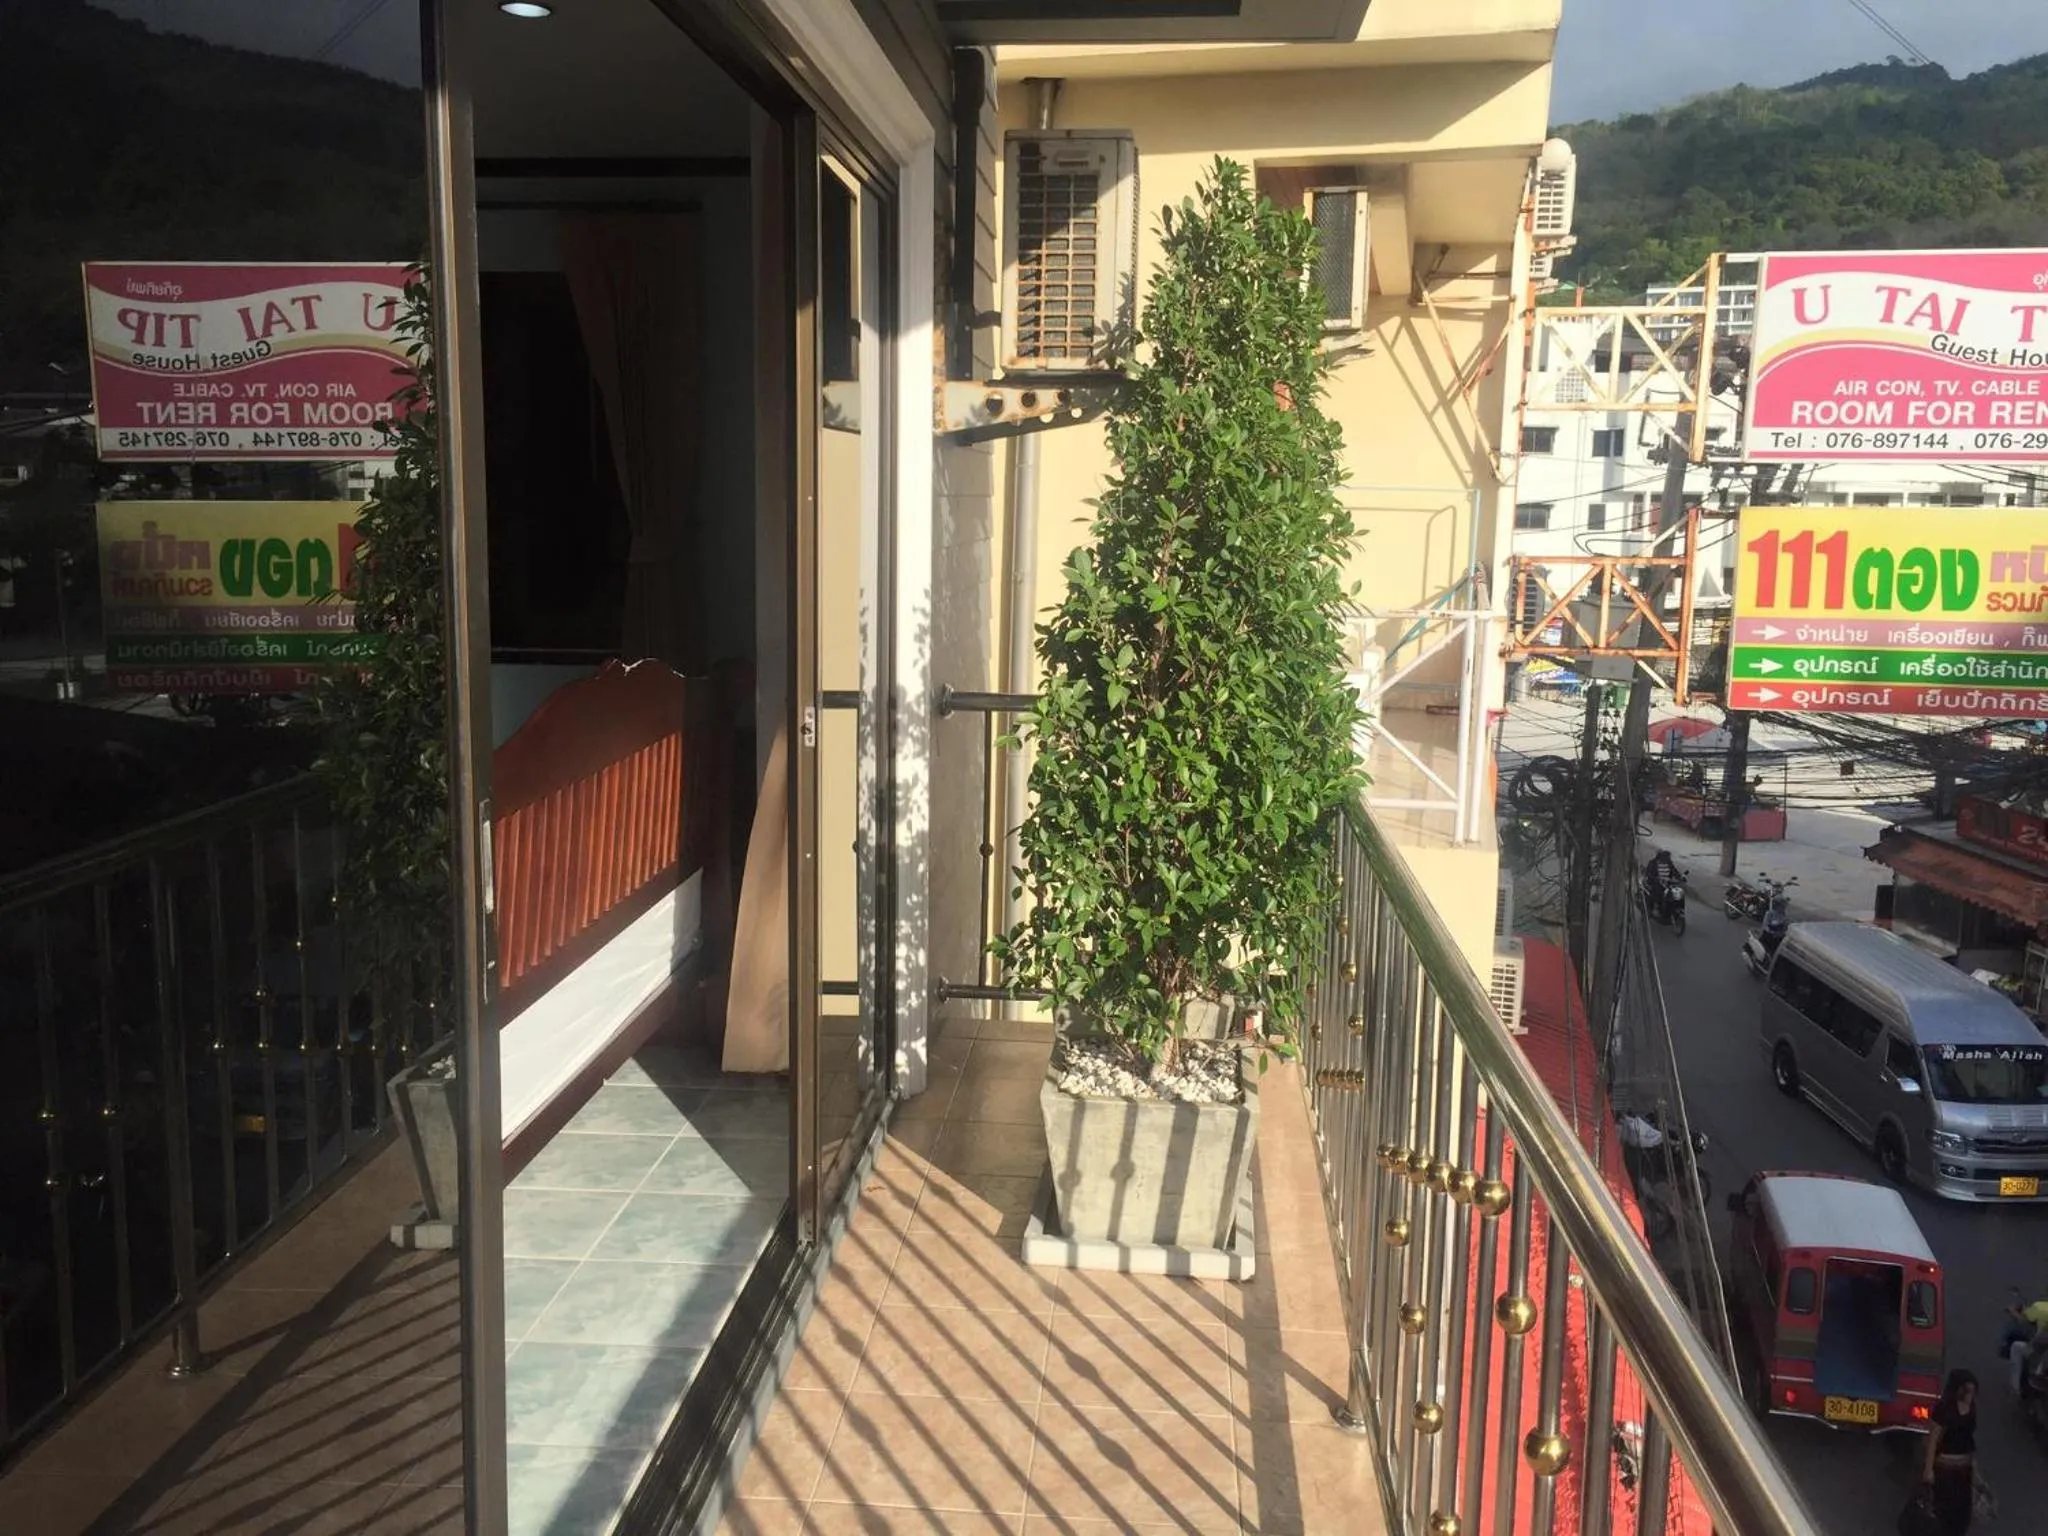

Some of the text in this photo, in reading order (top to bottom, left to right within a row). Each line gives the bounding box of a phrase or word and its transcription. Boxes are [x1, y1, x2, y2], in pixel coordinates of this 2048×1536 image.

[1792, 284, 1832, 325] U
[1875, 285, 1972, 336] TAI
[1930, 333, 1999, 365] Guest
[1834, 380, 1868, 397] AIR
[1971, 380, 2040, 397] CABLE
[1791, 401, 1893, 426] ROOM
[1907, 401, 1975, 426] FOR
[1771, 432, 1802, 449] Tel
[1826, 432, 1949, 450] 076-897144
[1796, 622, 1868, 643] จำหน่าย
[1887, 621, 1994, 645] เครื่องเขียน
[1793, 656, 1878, 678] อุปกรณ์
[1792, 688, 1892, 709] อุปกรณ์
[1942, 1049, 2043, 1062] Masha Allah
